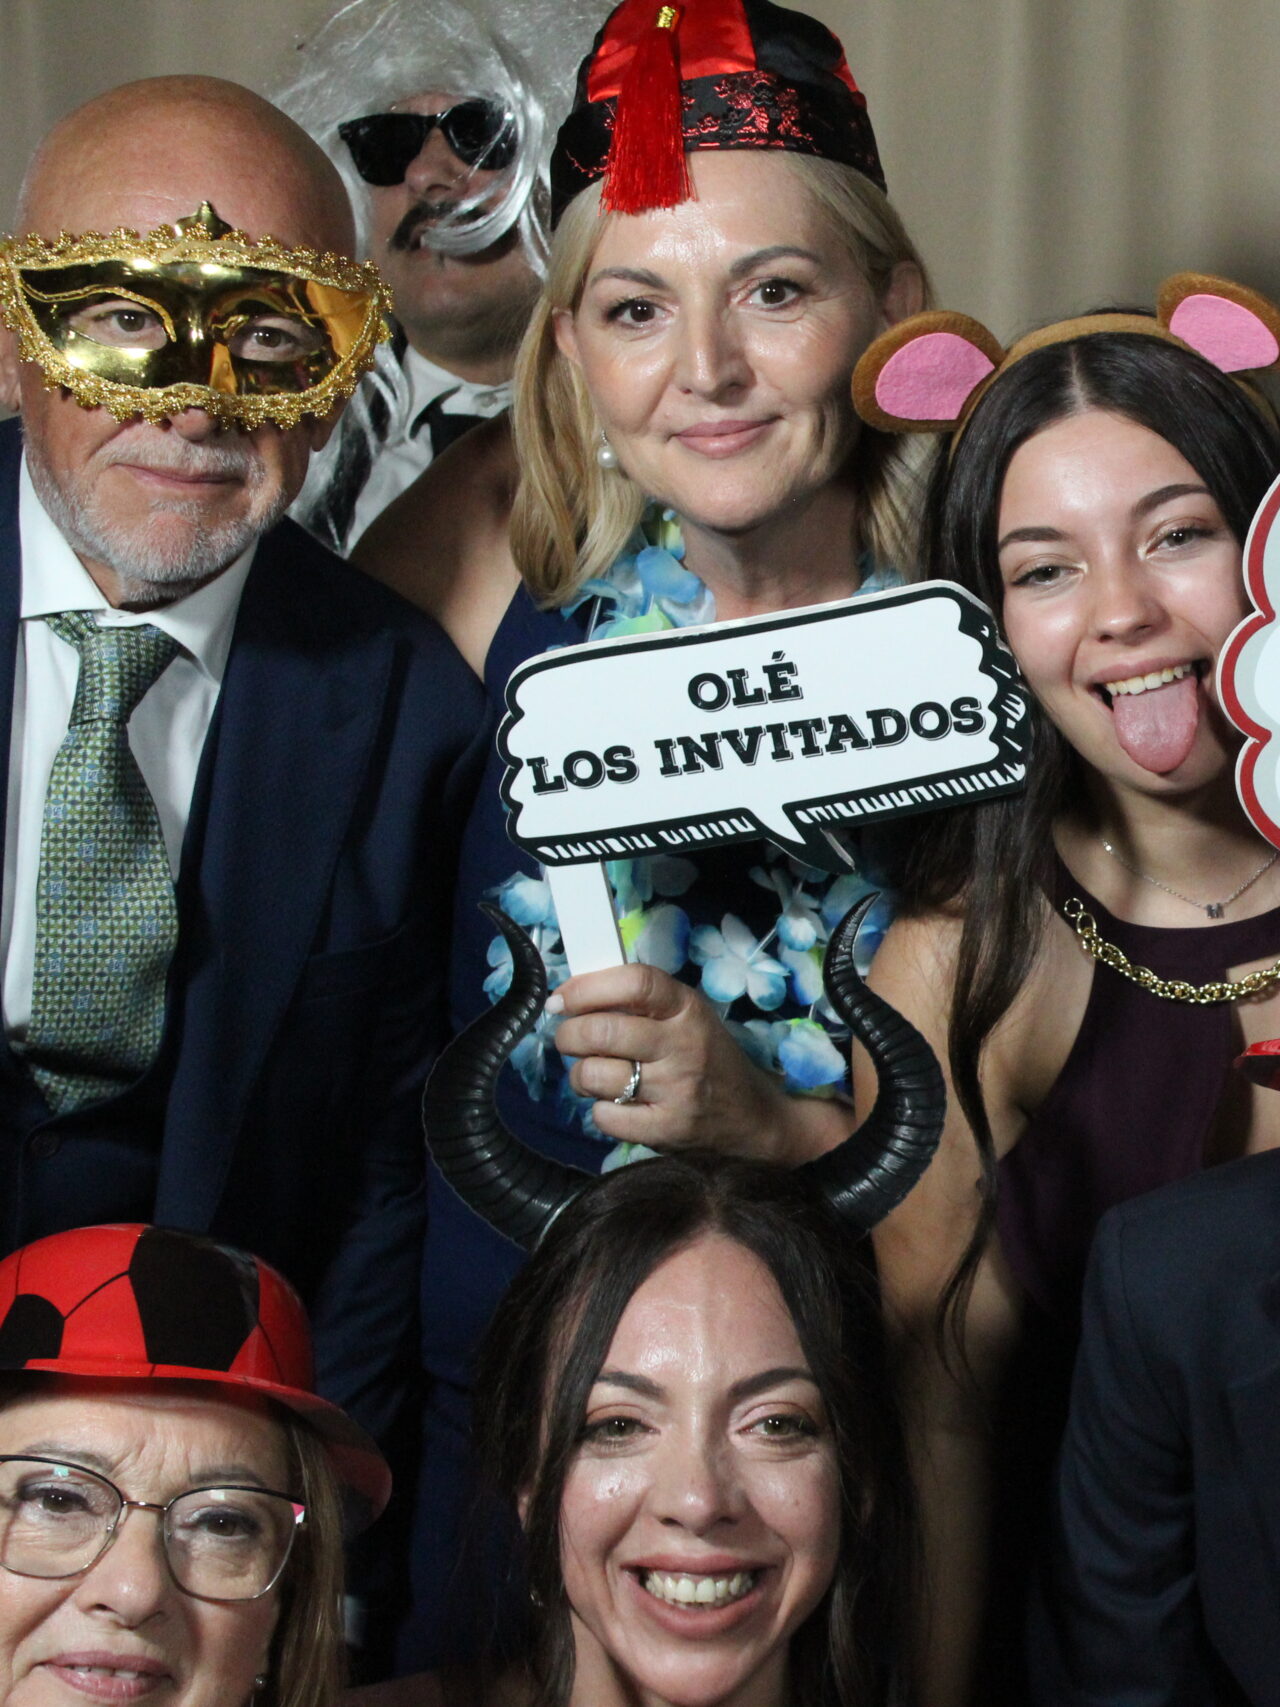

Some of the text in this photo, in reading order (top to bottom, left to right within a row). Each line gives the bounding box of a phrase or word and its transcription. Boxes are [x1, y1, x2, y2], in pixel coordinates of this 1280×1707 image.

[687, 650, 804, 713] OLÉ
[525, 696, 988, 796] LOS INVITADOS
